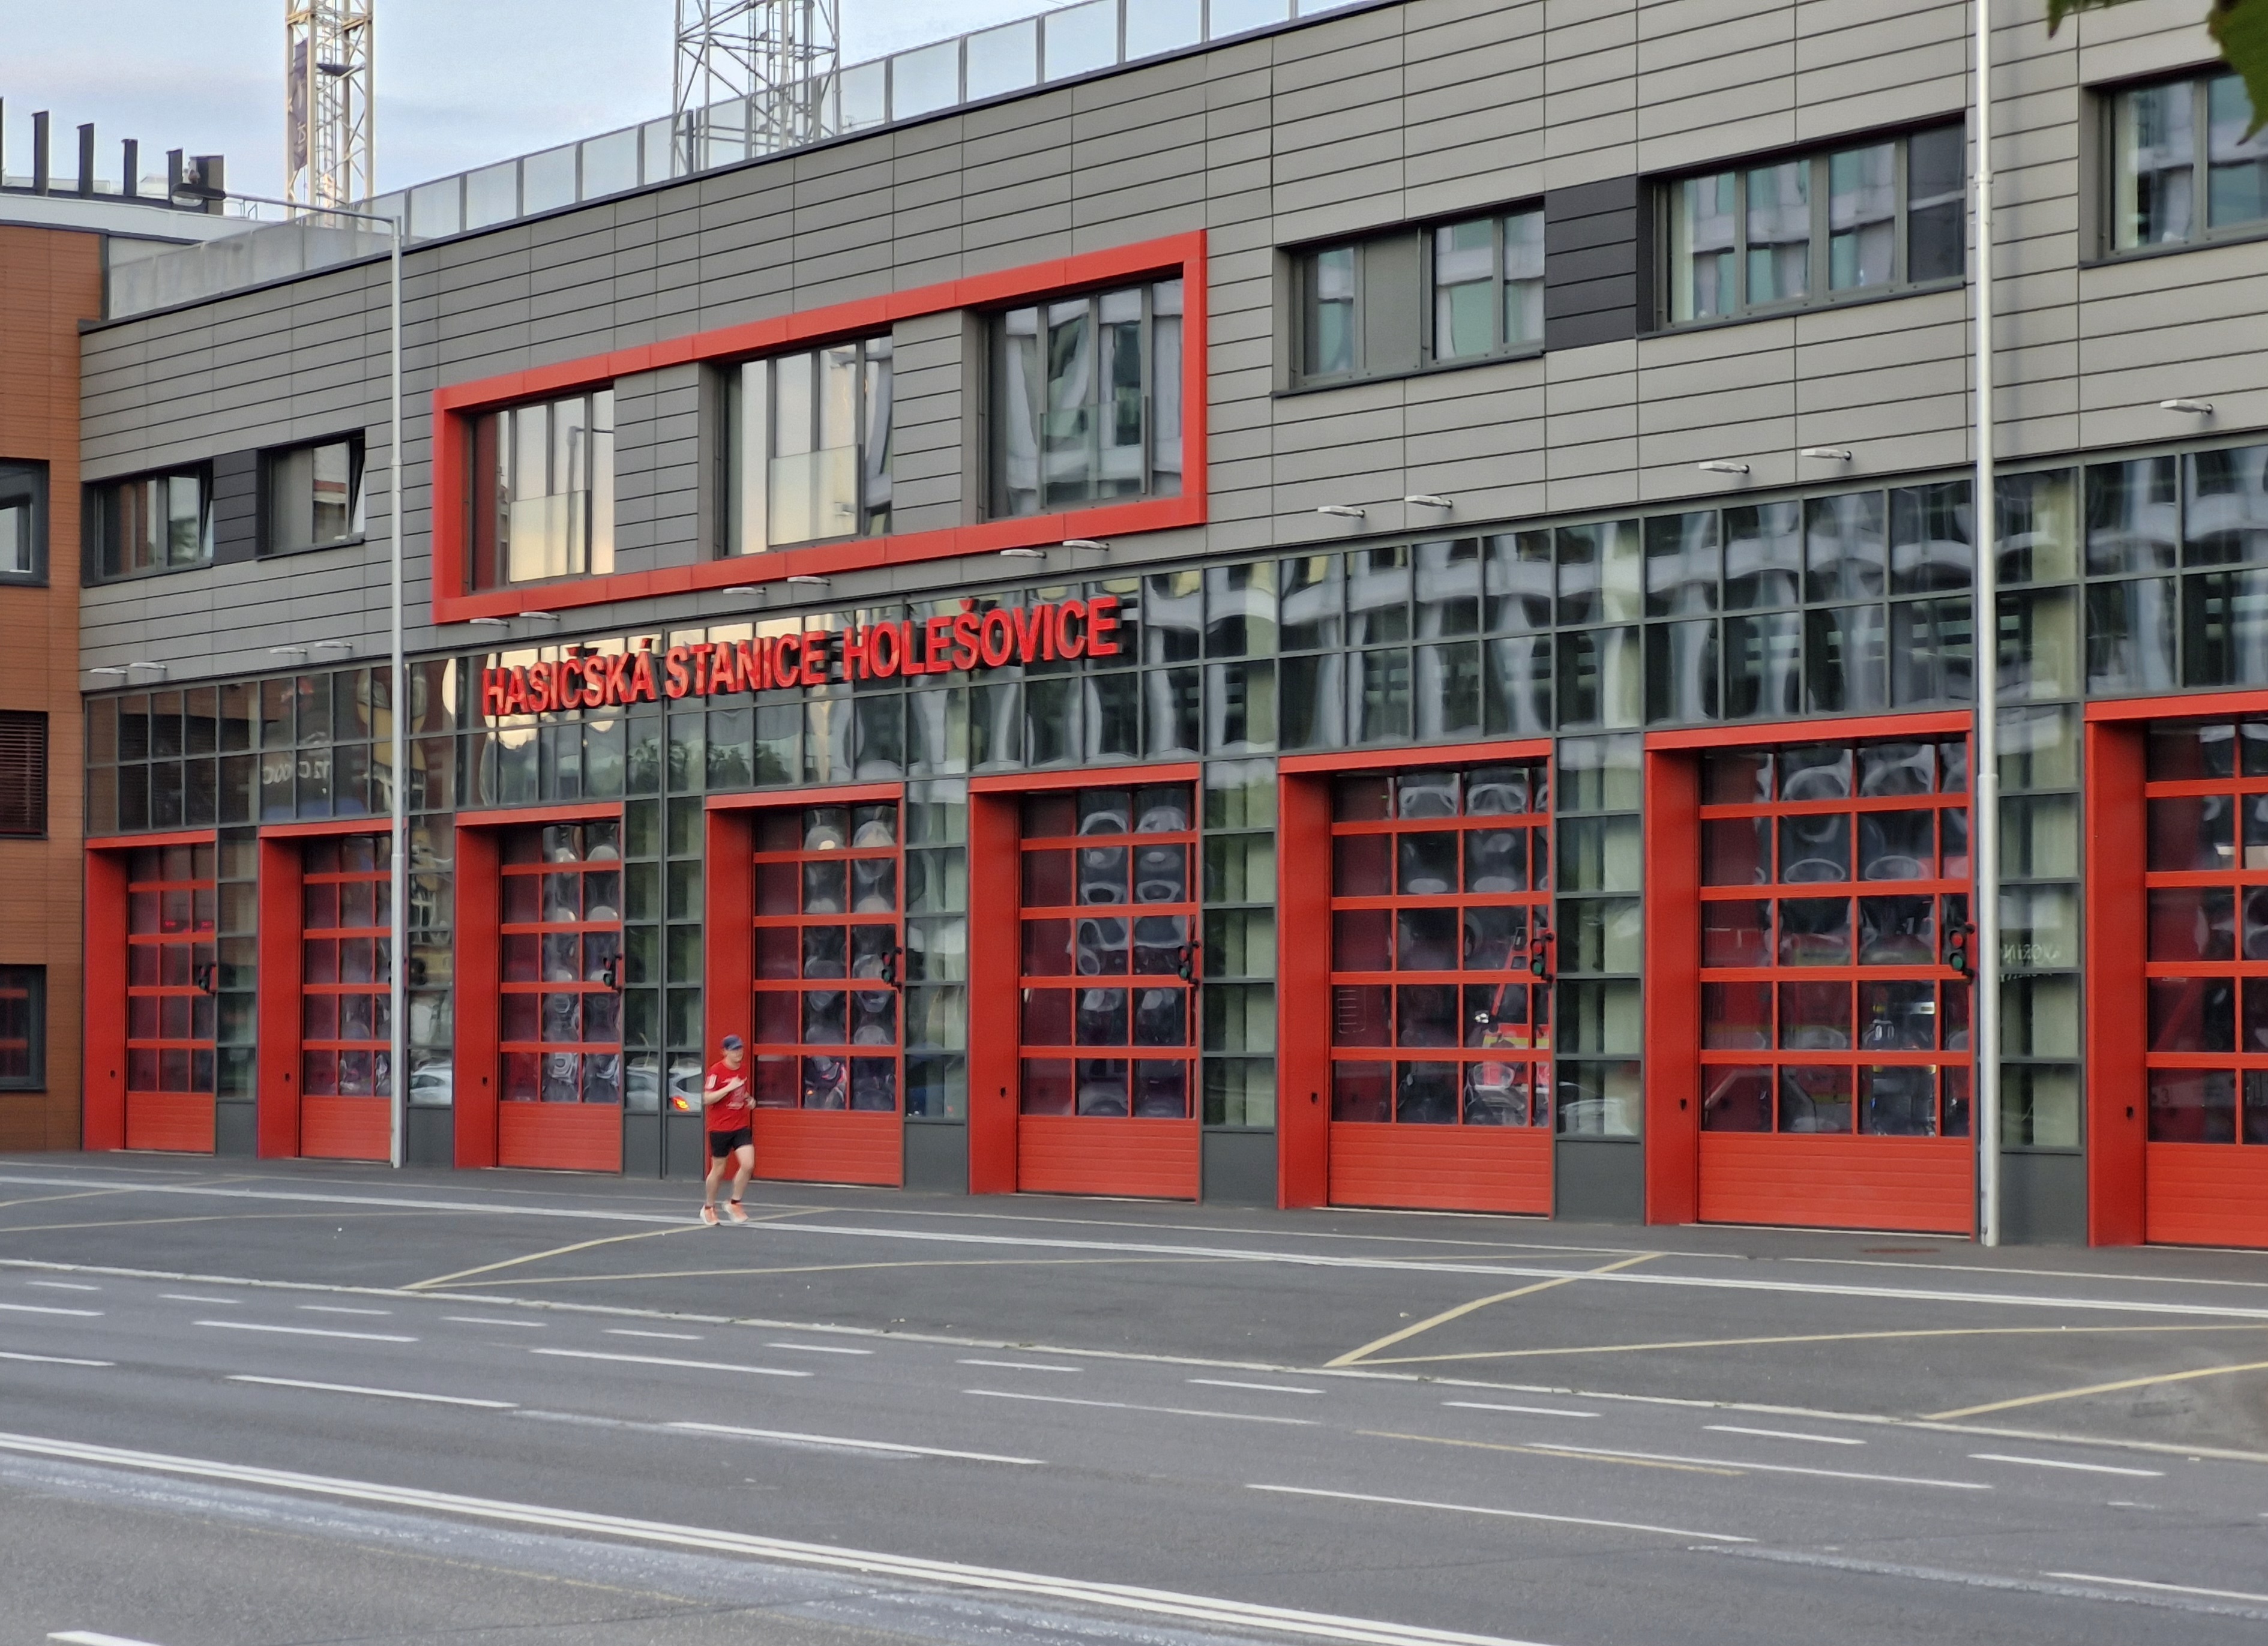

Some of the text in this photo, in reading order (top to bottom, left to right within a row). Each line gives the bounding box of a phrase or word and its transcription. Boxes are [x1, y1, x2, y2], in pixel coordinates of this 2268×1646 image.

[483, 596, 1119, 715] HASIČSKÁ STANICE HOLEŠOVICE
